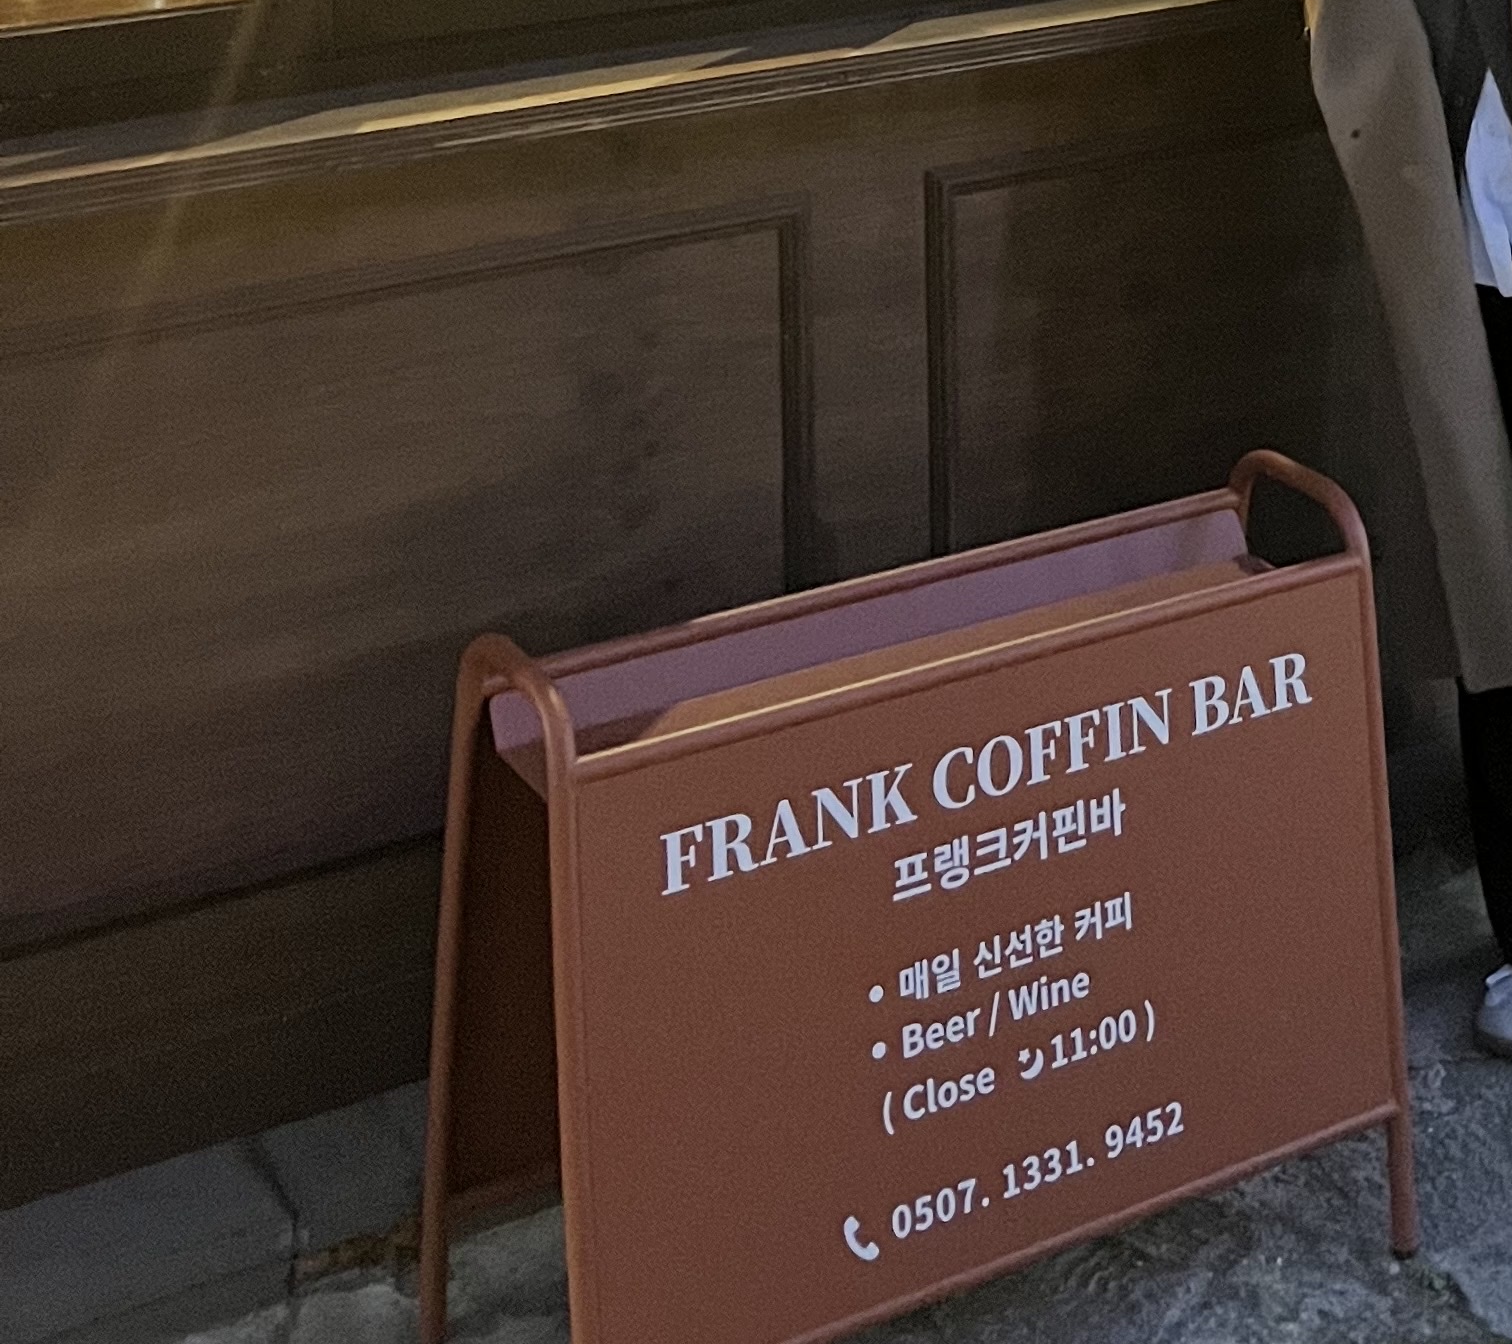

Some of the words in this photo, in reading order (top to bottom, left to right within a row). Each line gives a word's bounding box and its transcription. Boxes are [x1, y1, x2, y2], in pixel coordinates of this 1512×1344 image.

[660, 763, 917, 897] FRANK
[931, 687, 1174, 812] COFFIN
[1189, 652, 1313, 737] BAR
[891, 788, 1127, 902] 프랭크커핀바
[898, 950, 962, 1002] 매일
[972, 917, 1066, 981] 신선한
[1074, 892, 1134, 942] 커피
[901, 1000, 981, 1060] Beer
[1008, 967, 1092, 1023] Wine
[891, 1177, 991, 1242] 0507.
[1001, 1139, 1096, 1199] 1331.
[1105, 1100, 1185, 1162] 9452
